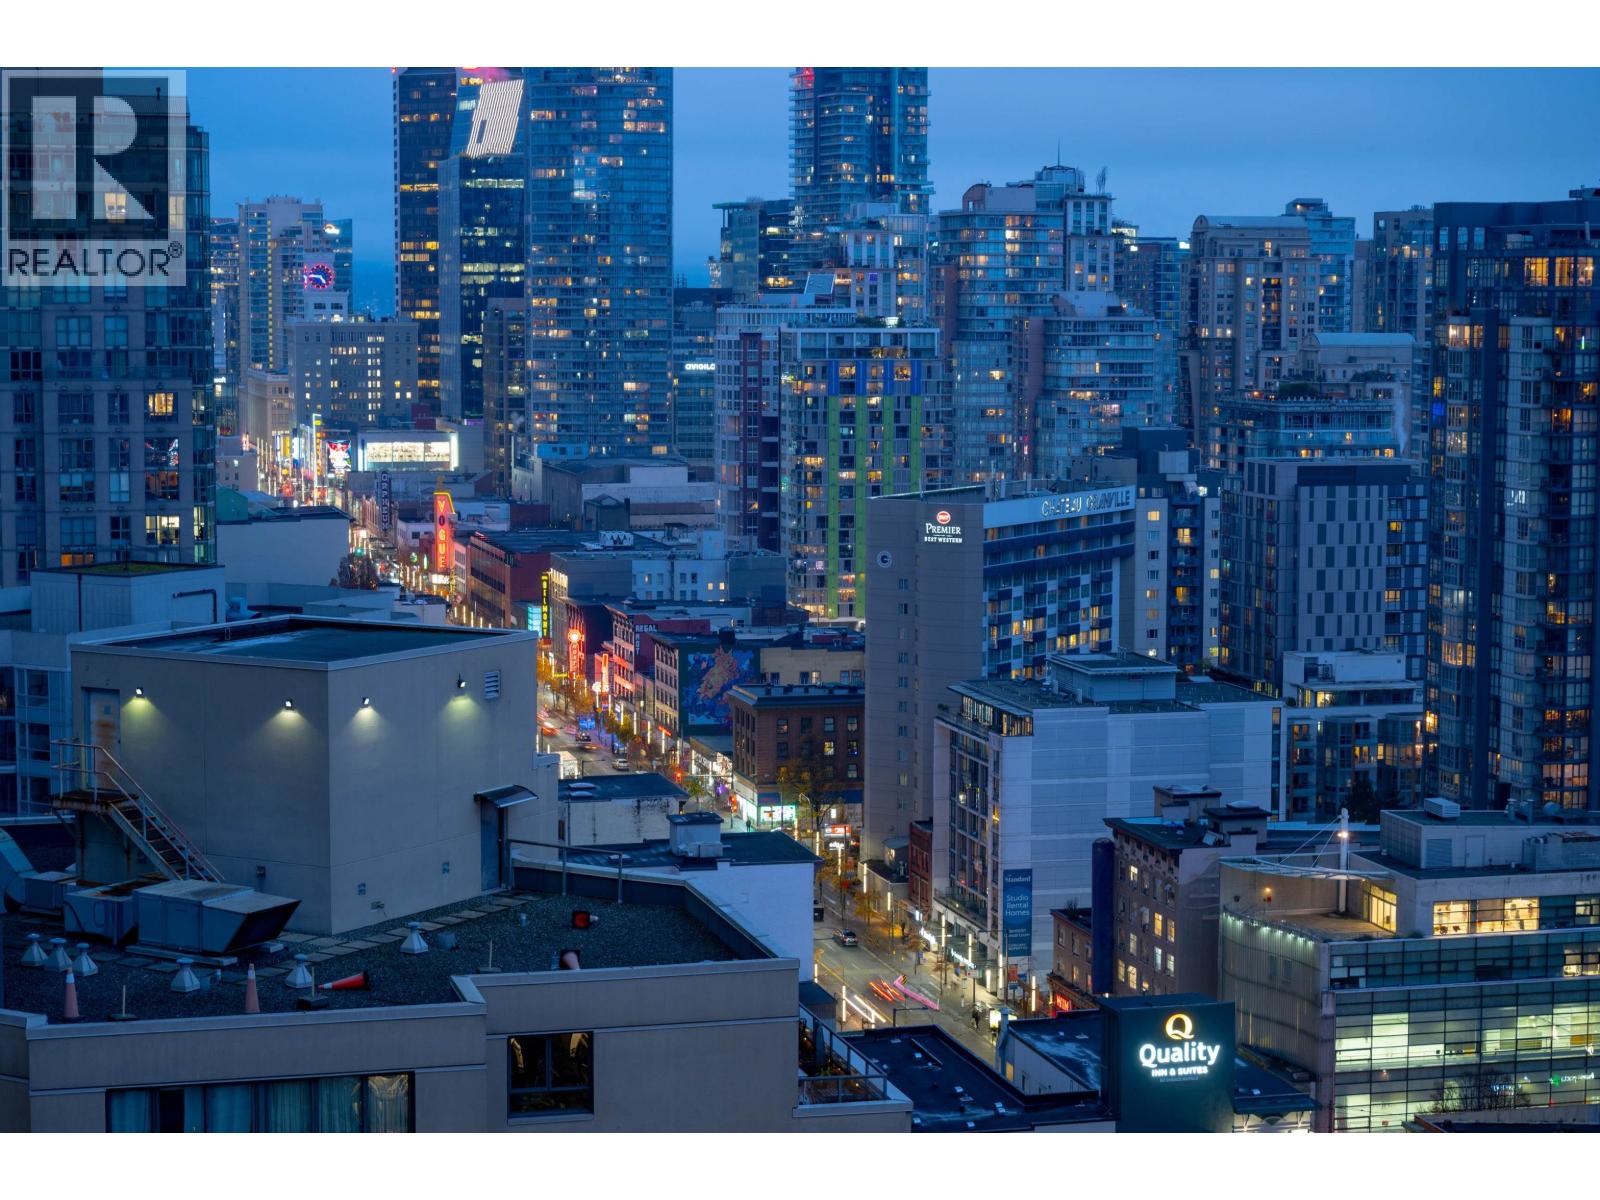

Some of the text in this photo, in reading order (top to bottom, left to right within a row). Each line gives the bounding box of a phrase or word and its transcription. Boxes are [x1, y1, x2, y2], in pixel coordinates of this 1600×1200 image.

[437, 500, 447, 569] VOGUE
[925, 522, 962, 535] PREMIER
[635, 624, 657, 632] REGAL
[1006, 894, 1029, 902] Studio
[1005, 909, 1030, 917] Homes
[1139, 1041, 1220, 1068] Quality
[1151, 1068, 1168, 1077] INN
[1177, 1065, 1209, 1075] SUITES
